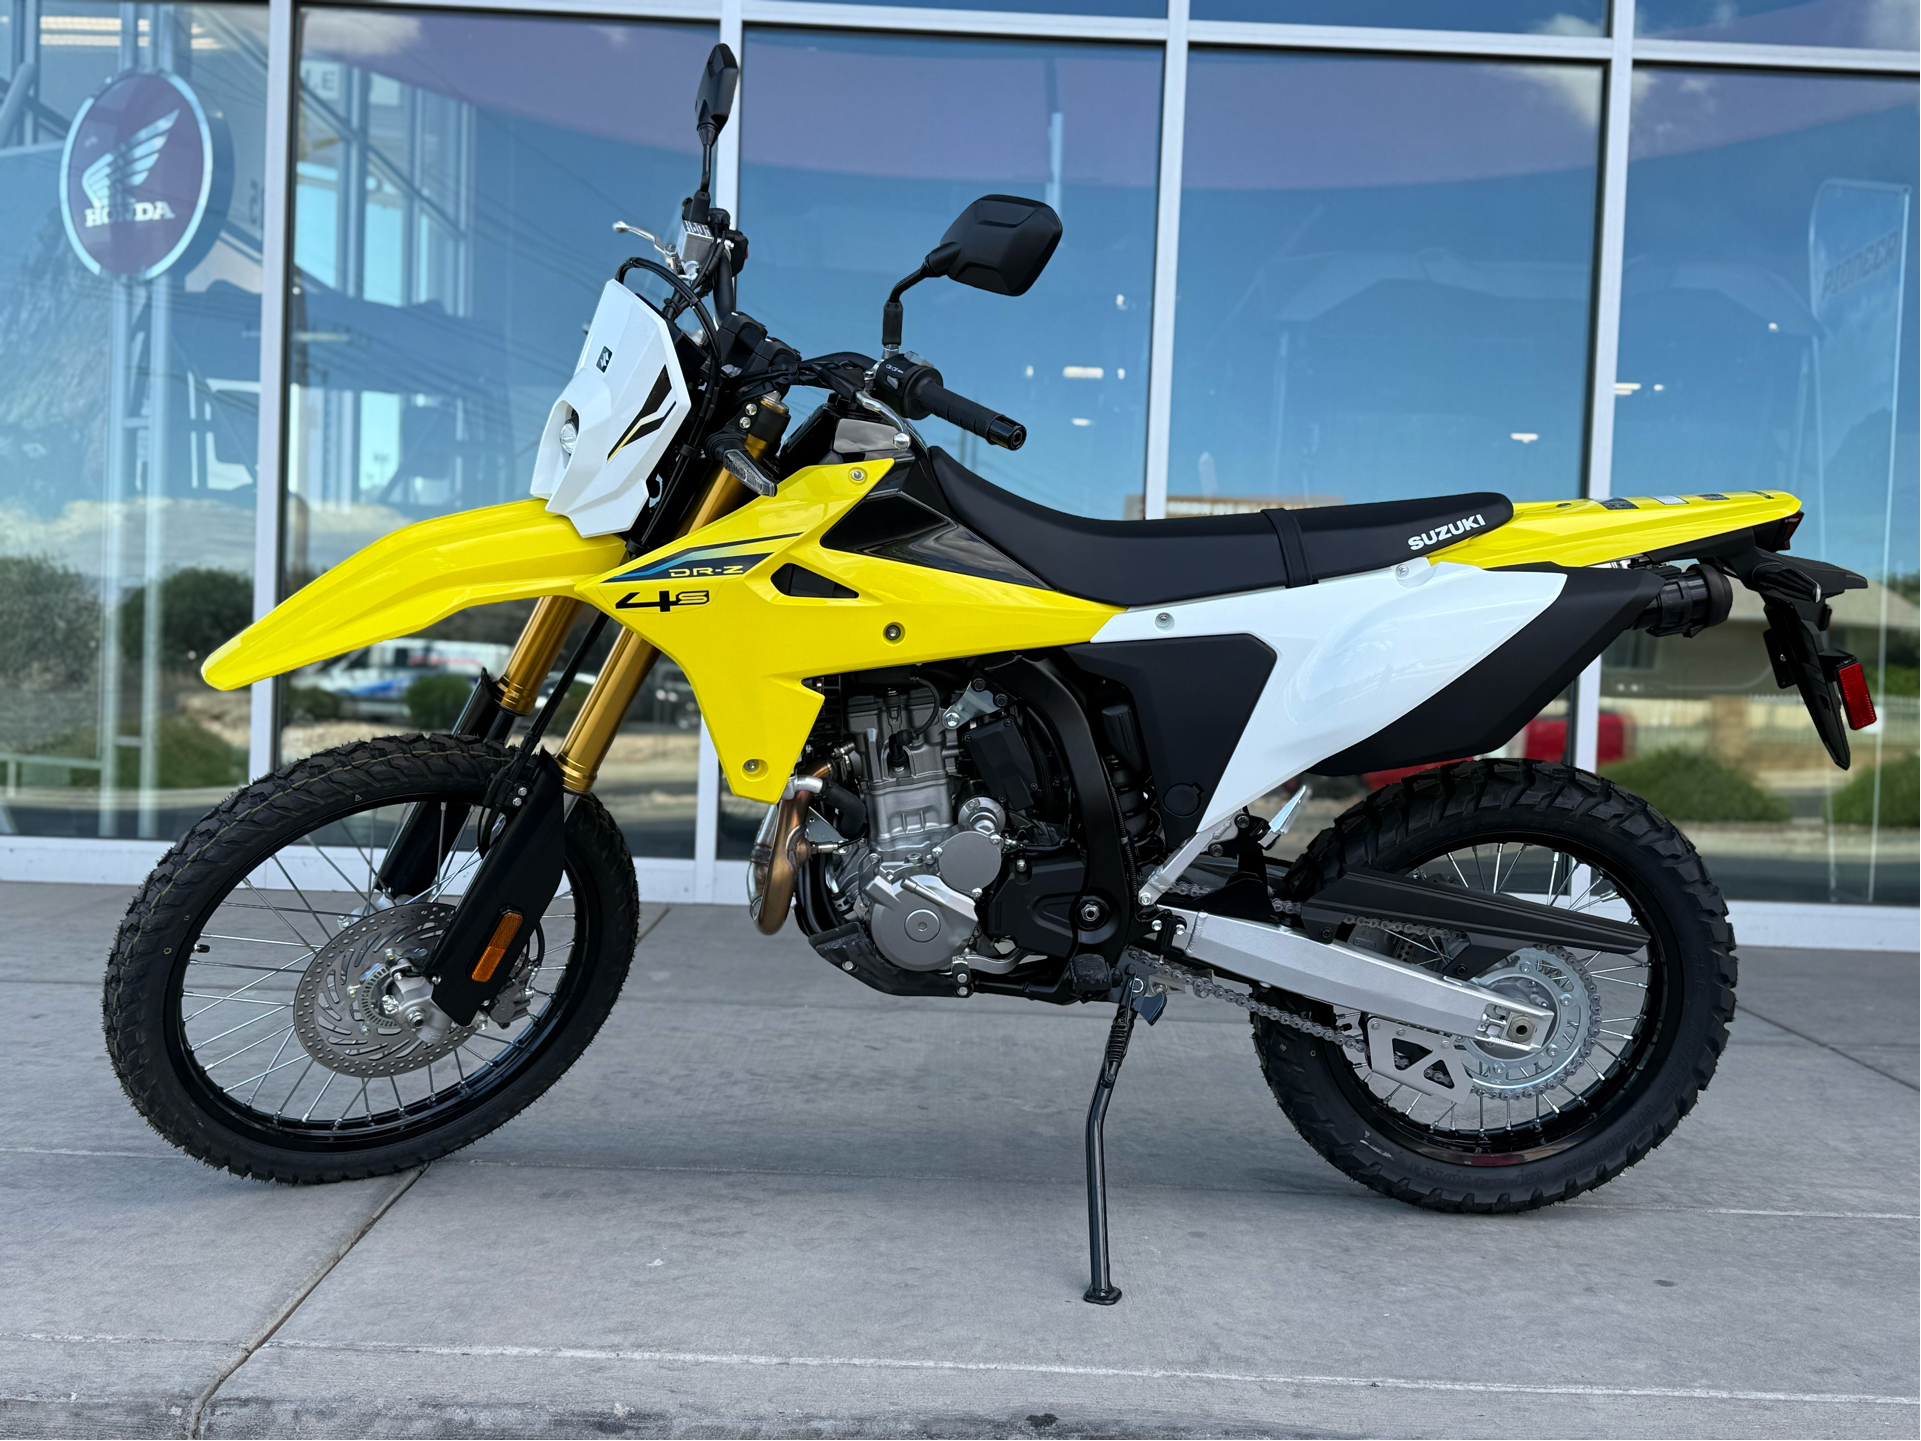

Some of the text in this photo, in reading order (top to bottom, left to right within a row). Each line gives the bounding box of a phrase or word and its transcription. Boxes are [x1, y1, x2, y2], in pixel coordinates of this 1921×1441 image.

[85, 201, 175, 227] HONDA
[1408, 514, 1486, 550] SUZUKI
[669, 565, 743, 577] DR-Z
[615, 590, 709, 612] 4S
[1663, 1021, 1705, 1095] TRAIL
[1563, 1102, 1658, 1172] WINNER
